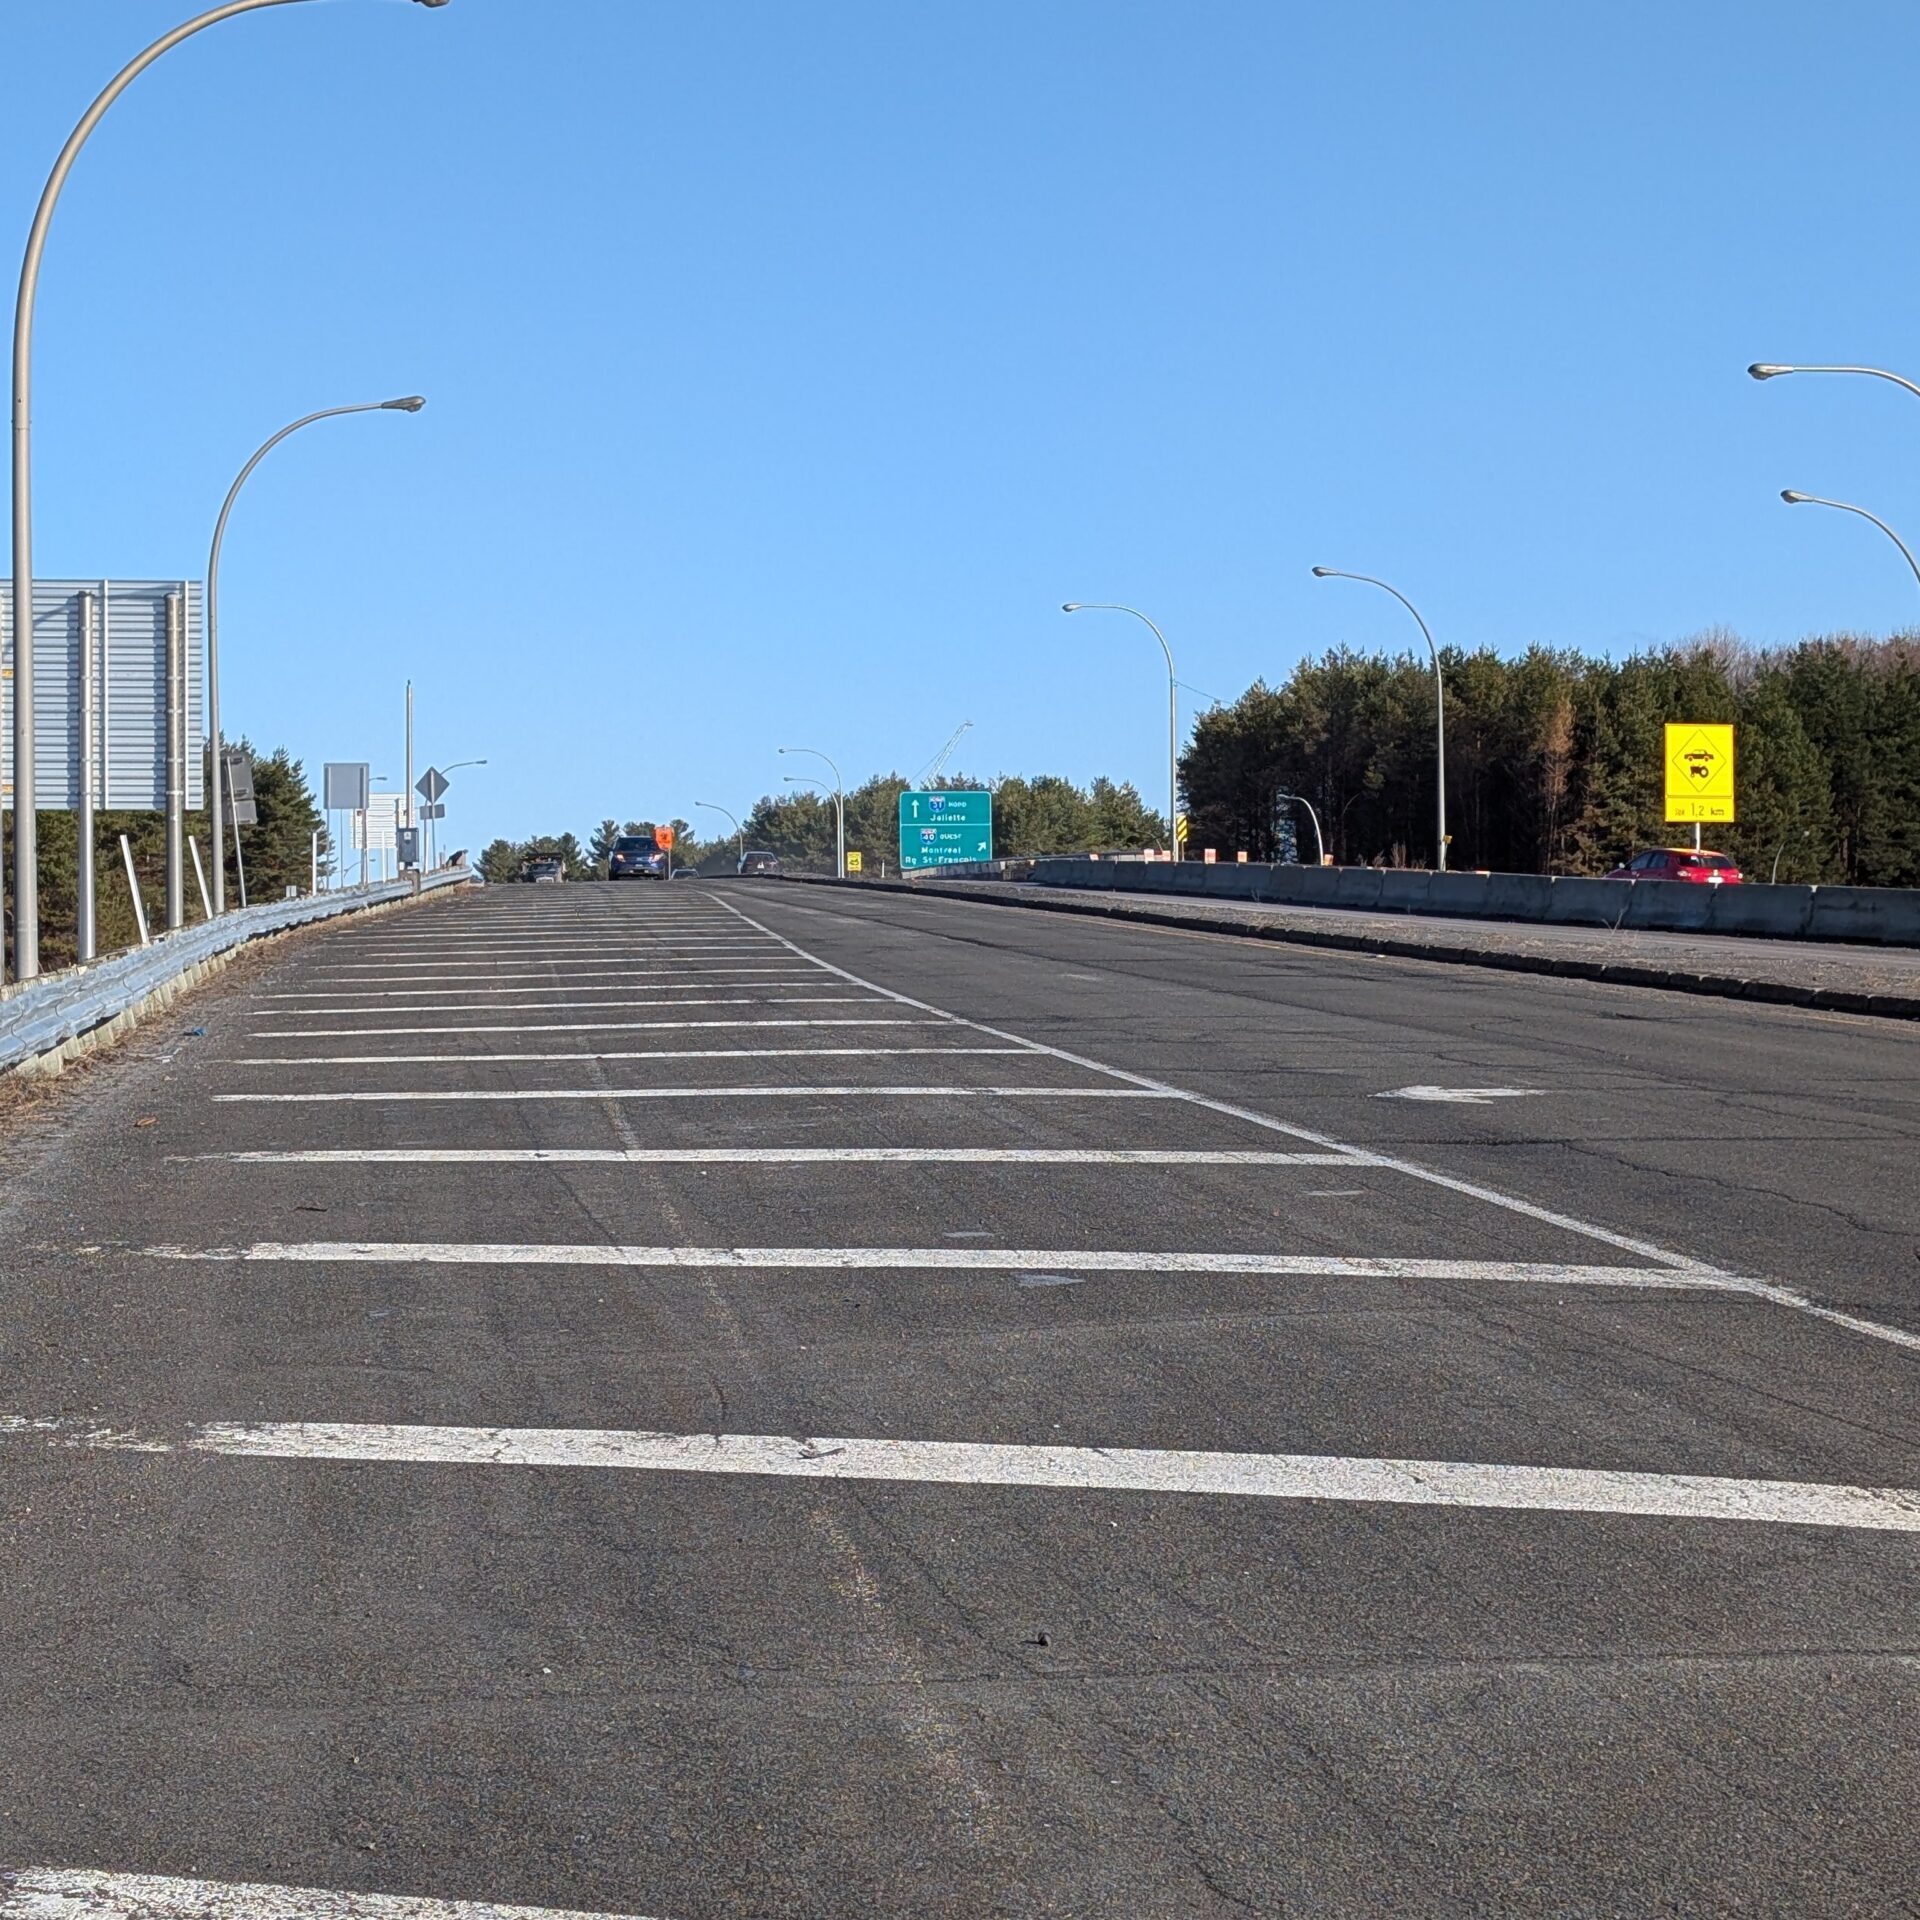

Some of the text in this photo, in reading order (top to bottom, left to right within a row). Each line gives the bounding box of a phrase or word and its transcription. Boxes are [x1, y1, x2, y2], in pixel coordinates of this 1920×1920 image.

[1710, 807, 1725, 816] km
[930, 813, 966, 822] Joliette
[923, 833, 935, 841] 40
